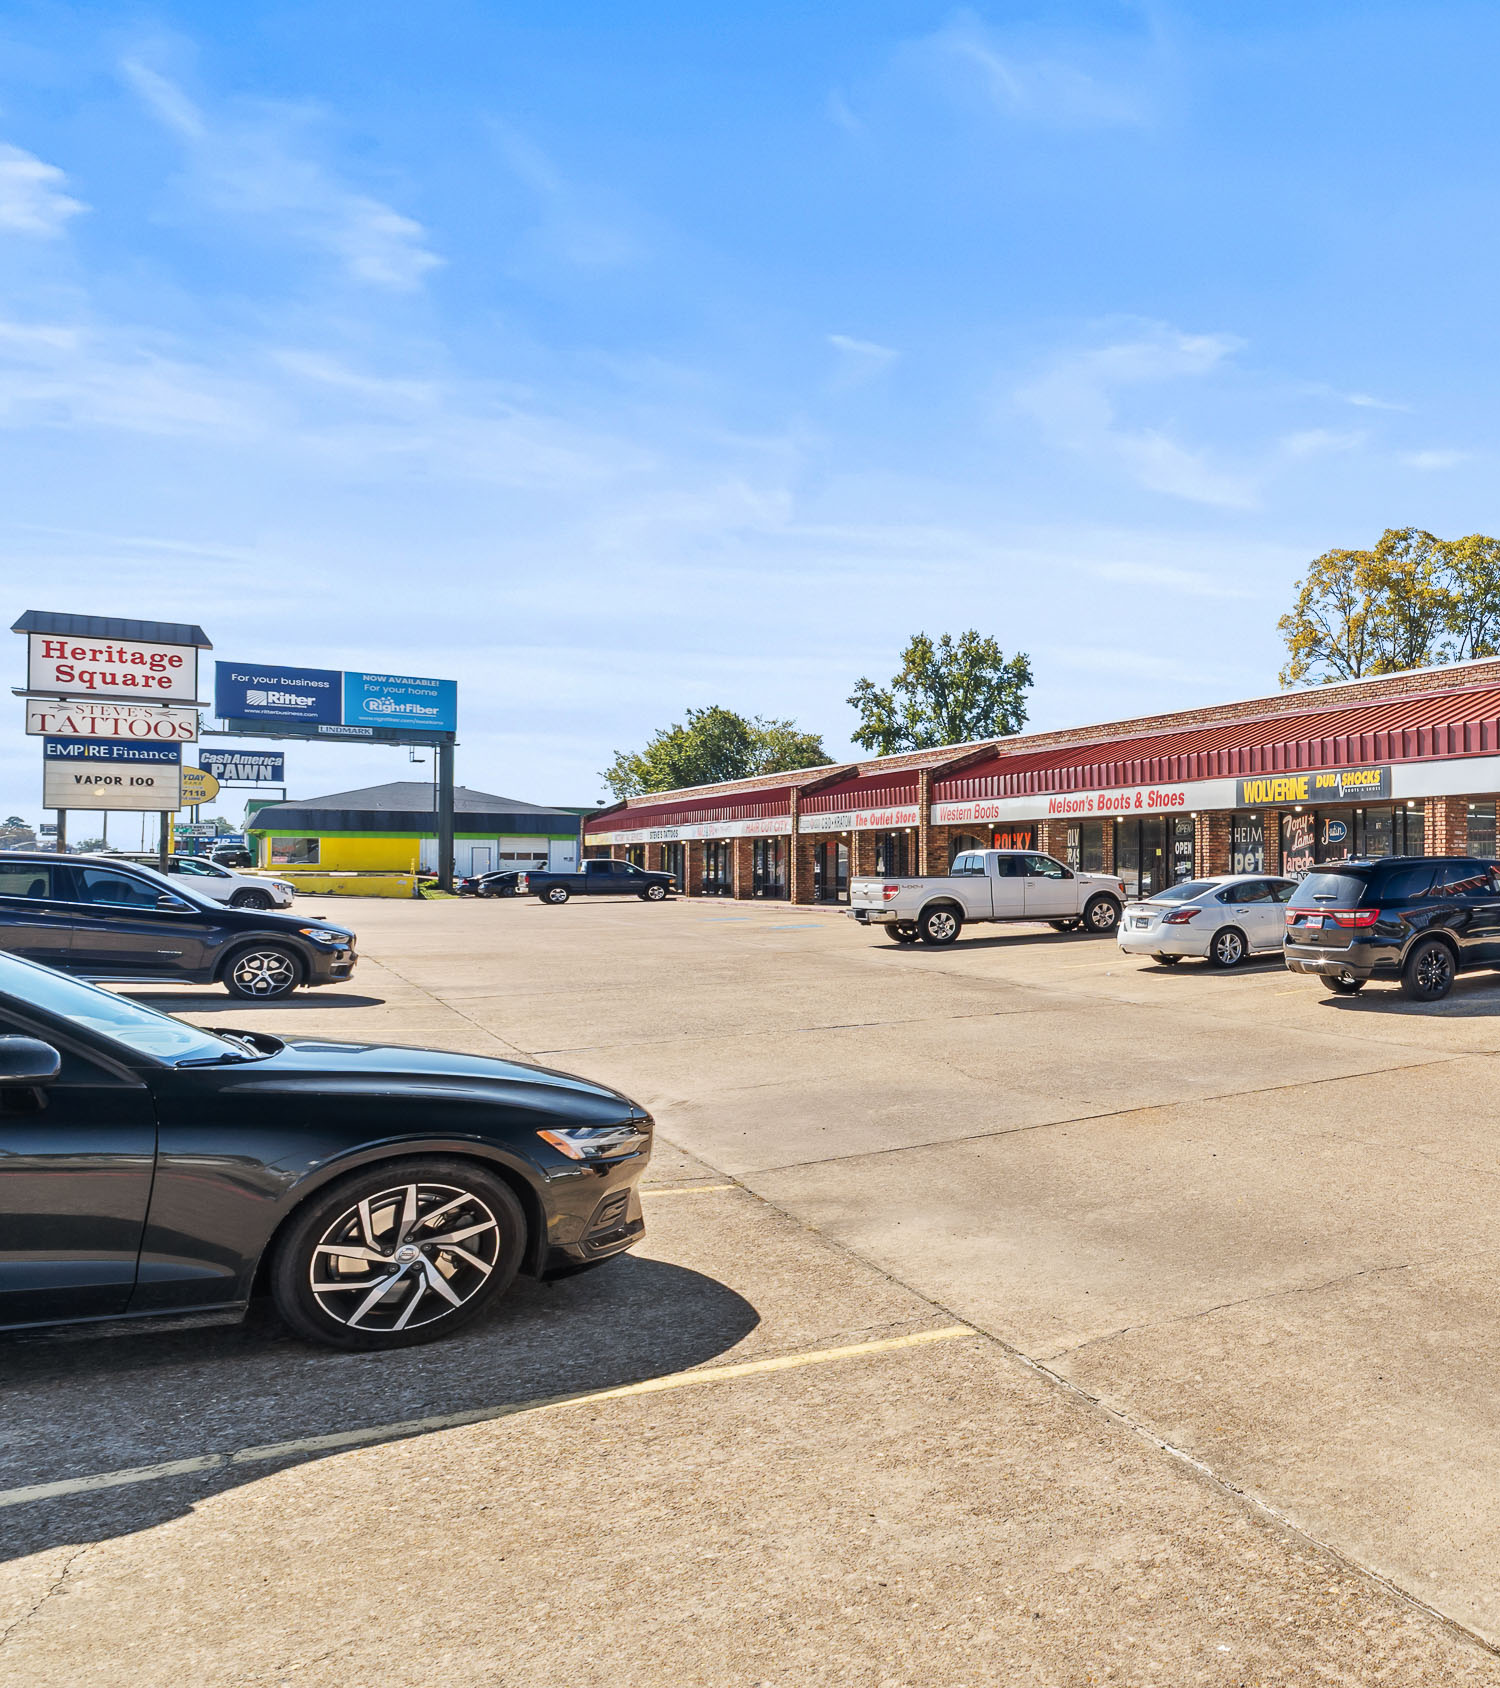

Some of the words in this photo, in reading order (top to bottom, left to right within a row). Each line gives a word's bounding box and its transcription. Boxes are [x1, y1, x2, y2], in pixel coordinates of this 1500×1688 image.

[41, 640, 183, 672] Heritage
[56, 664, 172, 689] Square
[232, 673, 250, 682] For
[252, 676, 278, 685] your
[281, 677, 330, 688] business
[388, 676, 439, 687] AVAILABLE!
[268, 691, 316, 706] Ritter
[383, 686, 406, 694] your
[408, 687, 438, 696] home
[76, 705, 153, 718] STEVE'S
[369, 700, 439, 714] RightFiber
[31, 713, 194, 739] TATTOOS
[47, 743, 109, 757] EMPIRE
[112, 747, 177, 760] Finance
[200, 752, 232, 764] Cash
[233, 754, 282, 766] America
[74, 775, 123, 785] VAPOR
[211, 764, 272, 780] PAWN
[1243, 776, 1309, 803] WOLVERINE
[1049, 794, 1094, 814] Nelson's
[1097, 793, 1130, 811] Boots
[1134, 793, 1143, 809] &
[1148, 790, 1185, 807] Shoes
[855, 814, 868, 826] The
[871, 812, 893, 826] Outlet
[895, 810, 917, 824] Store
[940, 805, 972, 822] Western
[974, 803, 999, 820] Boots
[1283, 814, 1308, 838] Tony
[1175, 842, 1192, 854] OPEN
[1292, 830, 1315, 850] Lama
